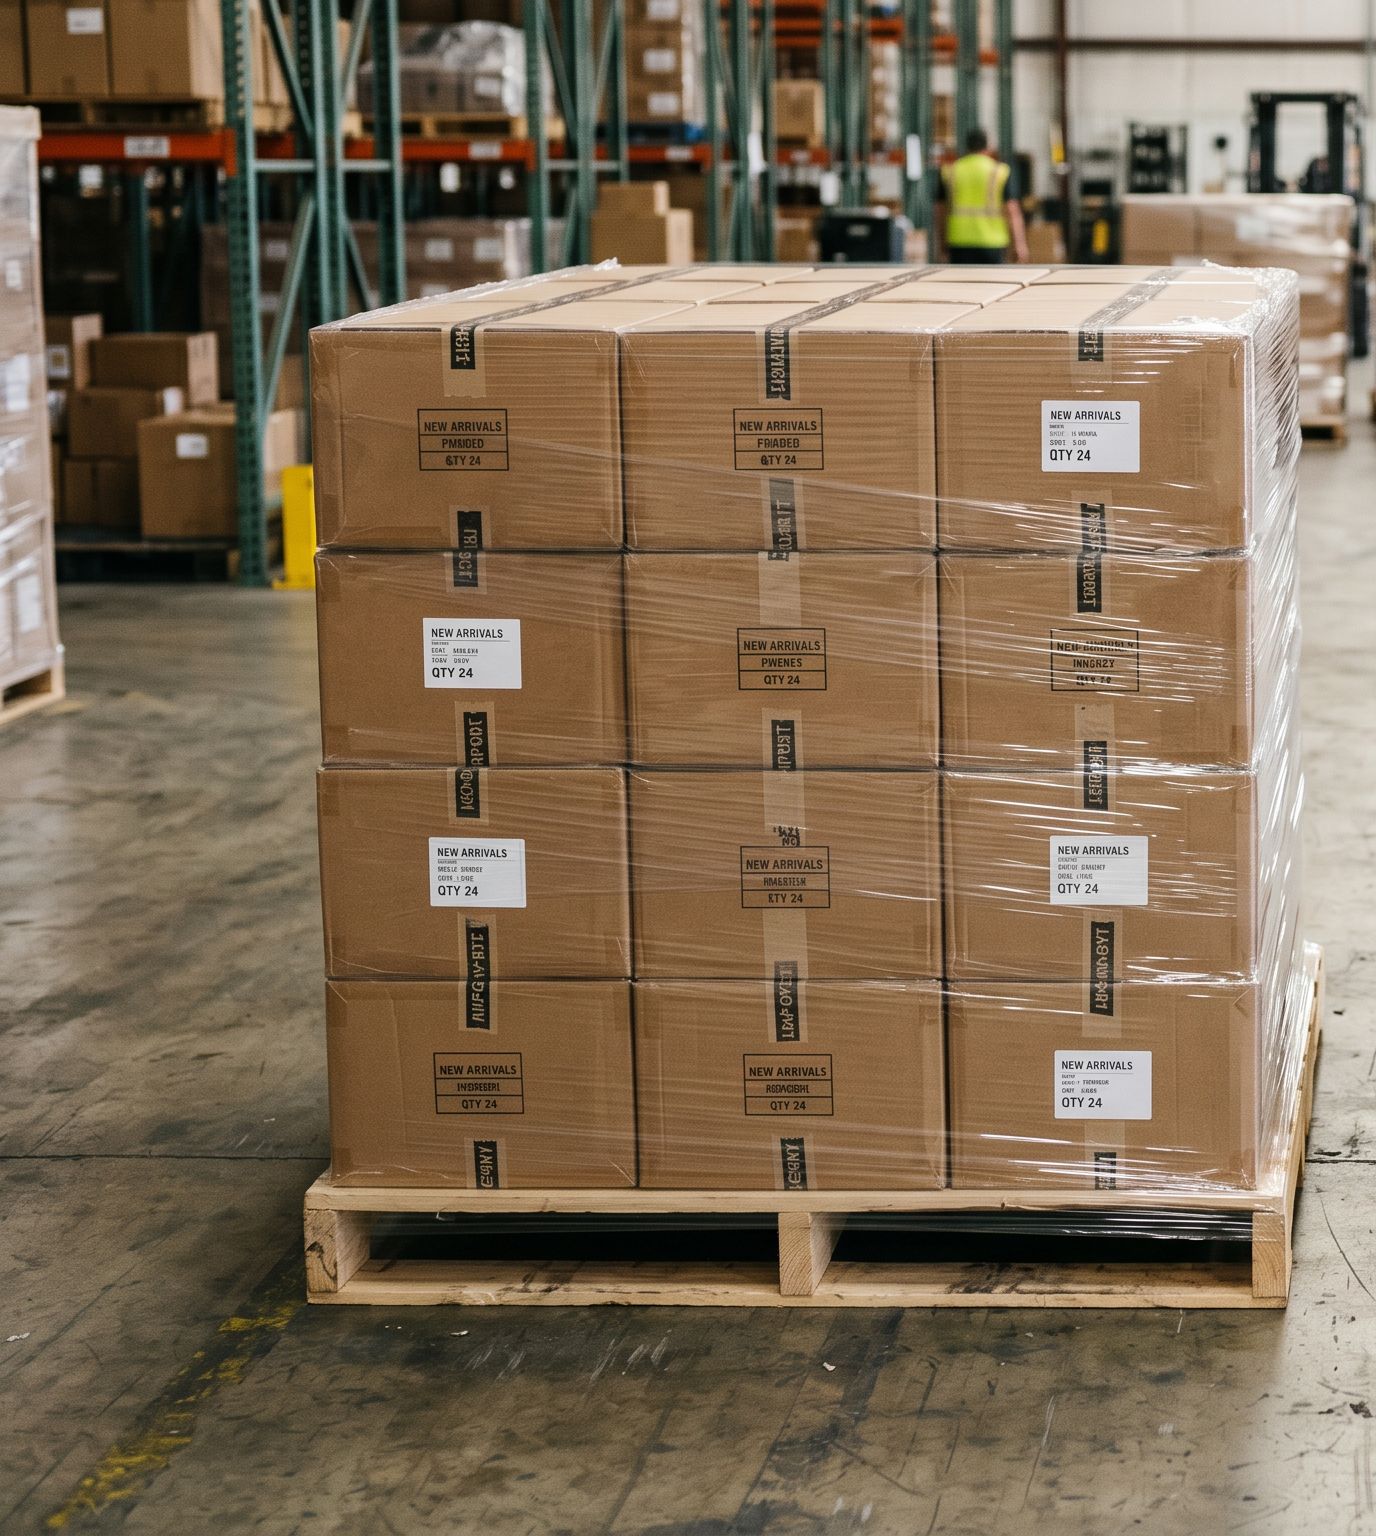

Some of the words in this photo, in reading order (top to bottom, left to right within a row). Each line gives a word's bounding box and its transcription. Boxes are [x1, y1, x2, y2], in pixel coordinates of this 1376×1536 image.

[1050, 410, 1072, 421] NEW
[1074, 410, 1122, 421] ARRIVALS
[424, 421, 450, 432] NEW
[450, 421, 502, 432] ARRIVALS
[739, 420, 764, 432] NEW
[766, 420, 818, 432] ARRIVALS
[468, 455, 481, 466] 24
[784, 454, 797, 466] 24
[1049, 448, 1073, 462] QTY
[1076, 448, 1092, 462] 24
[431, 628, 456, 640] NEW
[456, 628, 504, 640] ARRIVALS
[743, 640, 768, 652] NEW
[769, 640, 821, 652] ARRIVALS
[432, 666, 455, 679] QTY
[458, 666, 474, 679] 24
[763, 675, 786, 686] QTY
[787, 675, 801, 686] 24
[437, 847, 458, 858] NEW
[460, 847, 508, 858] ARRIVALS
[1057, 845, 1080, 856] NEW
[1082, 845, 1130, 856] ARRIVALS
[746, 858, 770, 870] NEW
[771, 858, 824, 870] ARRIVALS
[437, 884, 460, 897] QTY
[464, 884, 479, 897] 24
[1057, 882, 1081, 895] QTY
[1084, 882, 1099, 895] 24
[790, 893, 804, 904] 24
[439, 1065, 462, 1076] NEW
[464, 1065, 517, 1076] ARRIVALS
[1061, 1060, 1084, 1071] NEW
[1086, 1060, 1134, 1071] ARRIVALS
[748, 1066, 774, 1078] NEW
[776, 1066, 827, 1078] ARRIVALS
[461, 1099, 483, 1110] QTY
[484, 1099, 498, 1110] 24
[770, 1100, 792, 1111] QTY
[793, 1100, 807, 1111] 24
[1087, 1096, 1103, 1108] 24
